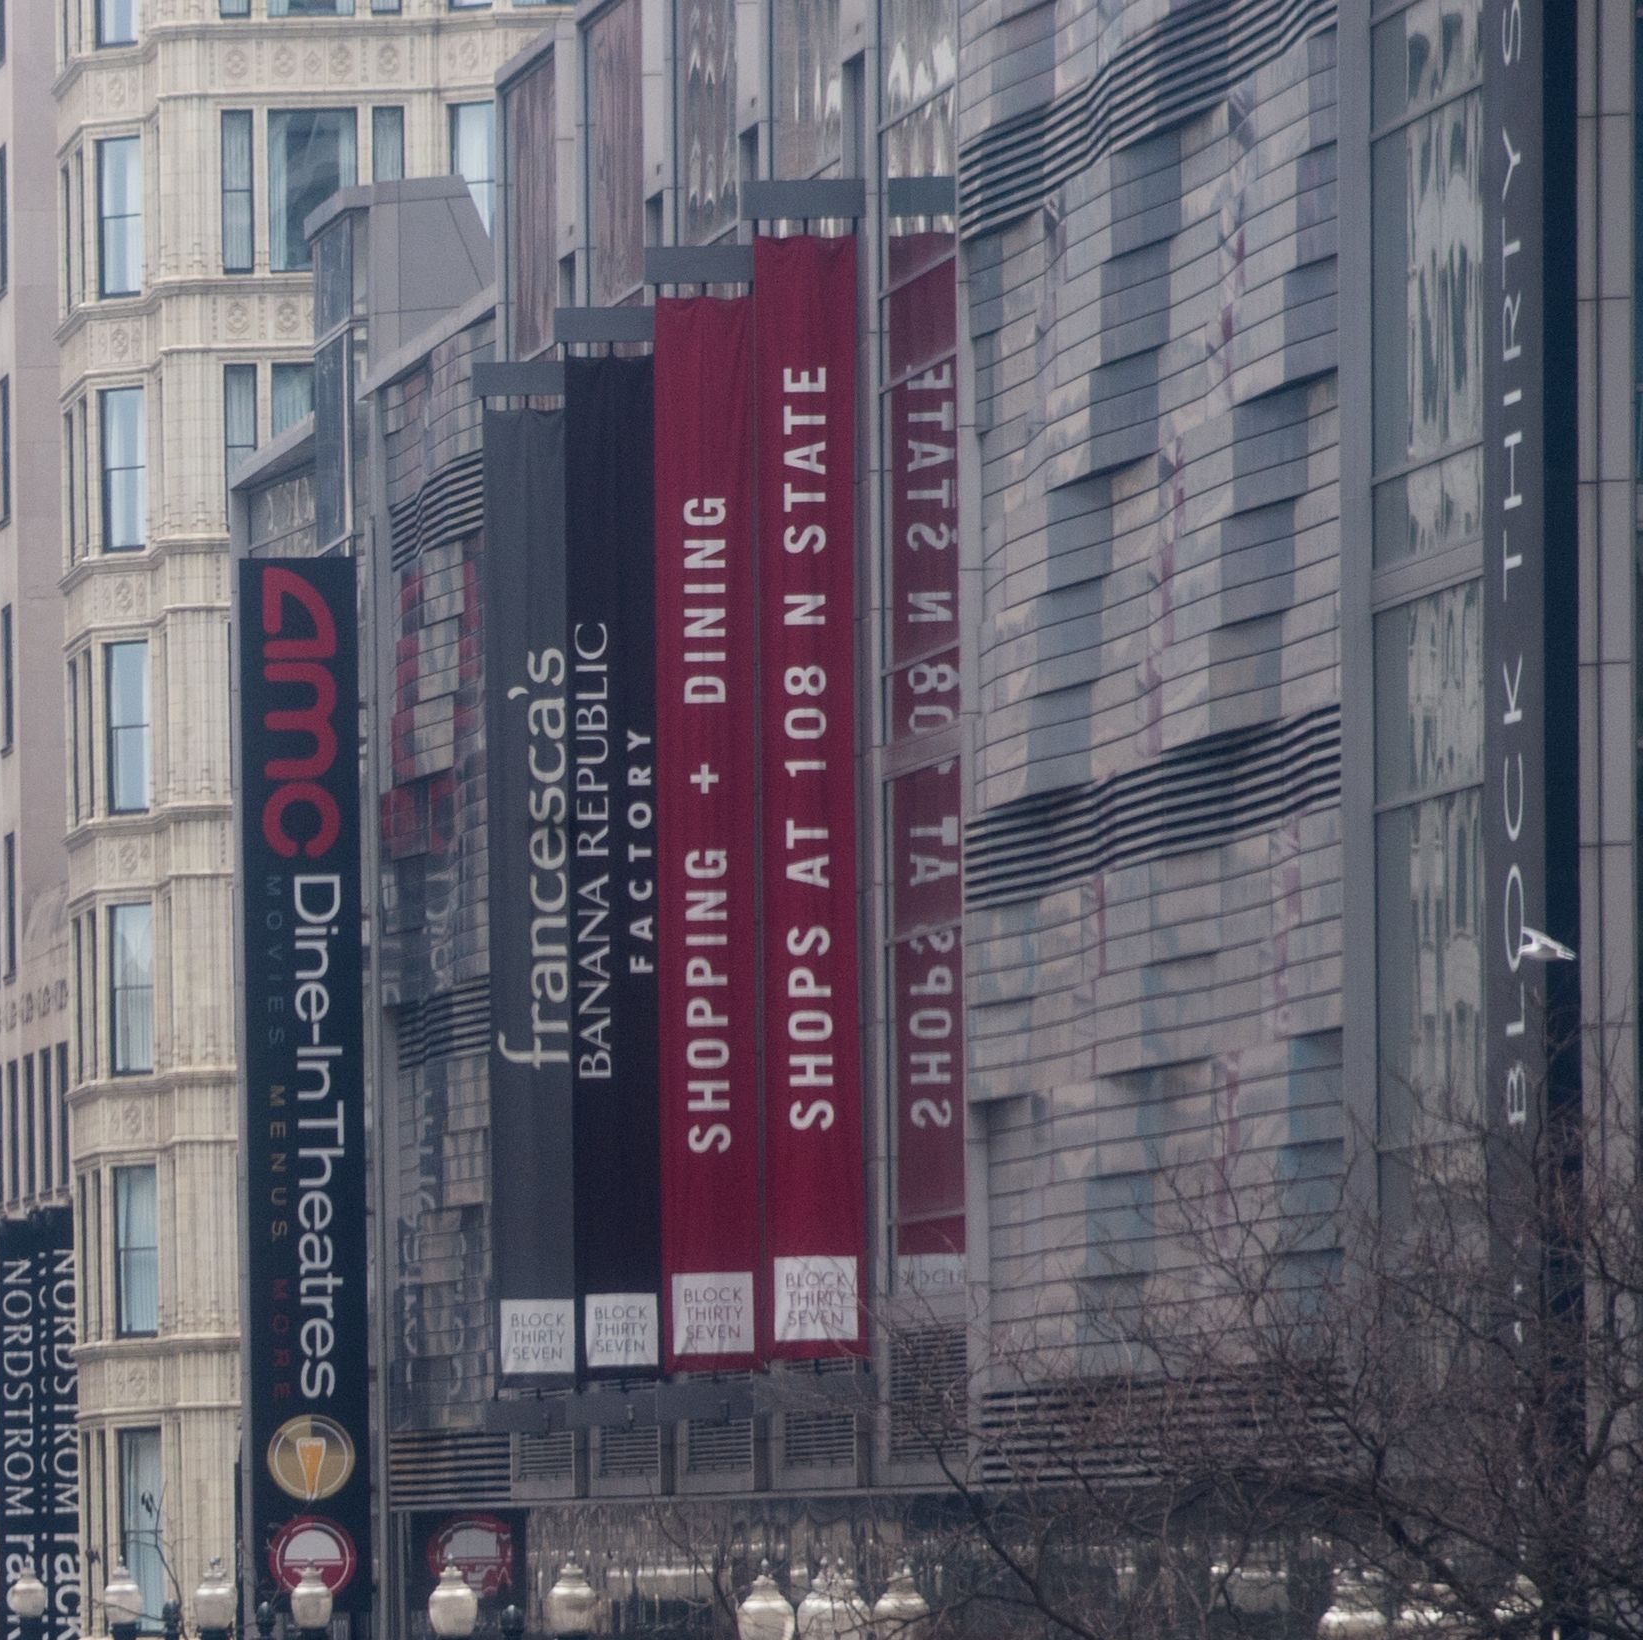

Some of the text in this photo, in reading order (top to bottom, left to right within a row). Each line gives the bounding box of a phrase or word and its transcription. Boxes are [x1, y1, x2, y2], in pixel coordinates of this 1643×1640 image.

[261, 566, 342, 861] amc
[782, 366, 834, 1130] SHOPS AT 108 N STATE
[682, 496, 732, 1154] SHOPPING DINING
[498, 647, 571, 1071] francesca's
[574, 622, 612, 1079] BANANA REPUBLIC
[626, 730, 654, 974] FACTORY
[1502, 652, 1527, 1126] BLOCK
[293, 874, 346, 1399] Dine-In Theatres
[785, 1271, 847, 1288] BLOCK
[683, 1287, 743, 1302] BLOCK
[787, 1289, 847, 1308] THIRTY
[511, 1313, 564, 1327] BLOCK
[594, 1306, 647, 1320] BLOCK
[684, 1305, 743, 1321] THIRTY
[787, 1309, 845, 1327] SEVEN
[512, 1330, 565, 1344] THIRTY
[595, 1322, 648, 1336] THIRTY
[685, 1324, 741, 1340] SEVEN
[512, 1347, 563, 1361] SEVEN
[595, 1339, 645, 1353] SEVEN
[2, 1259, 35, 1517] NORDSTROM
